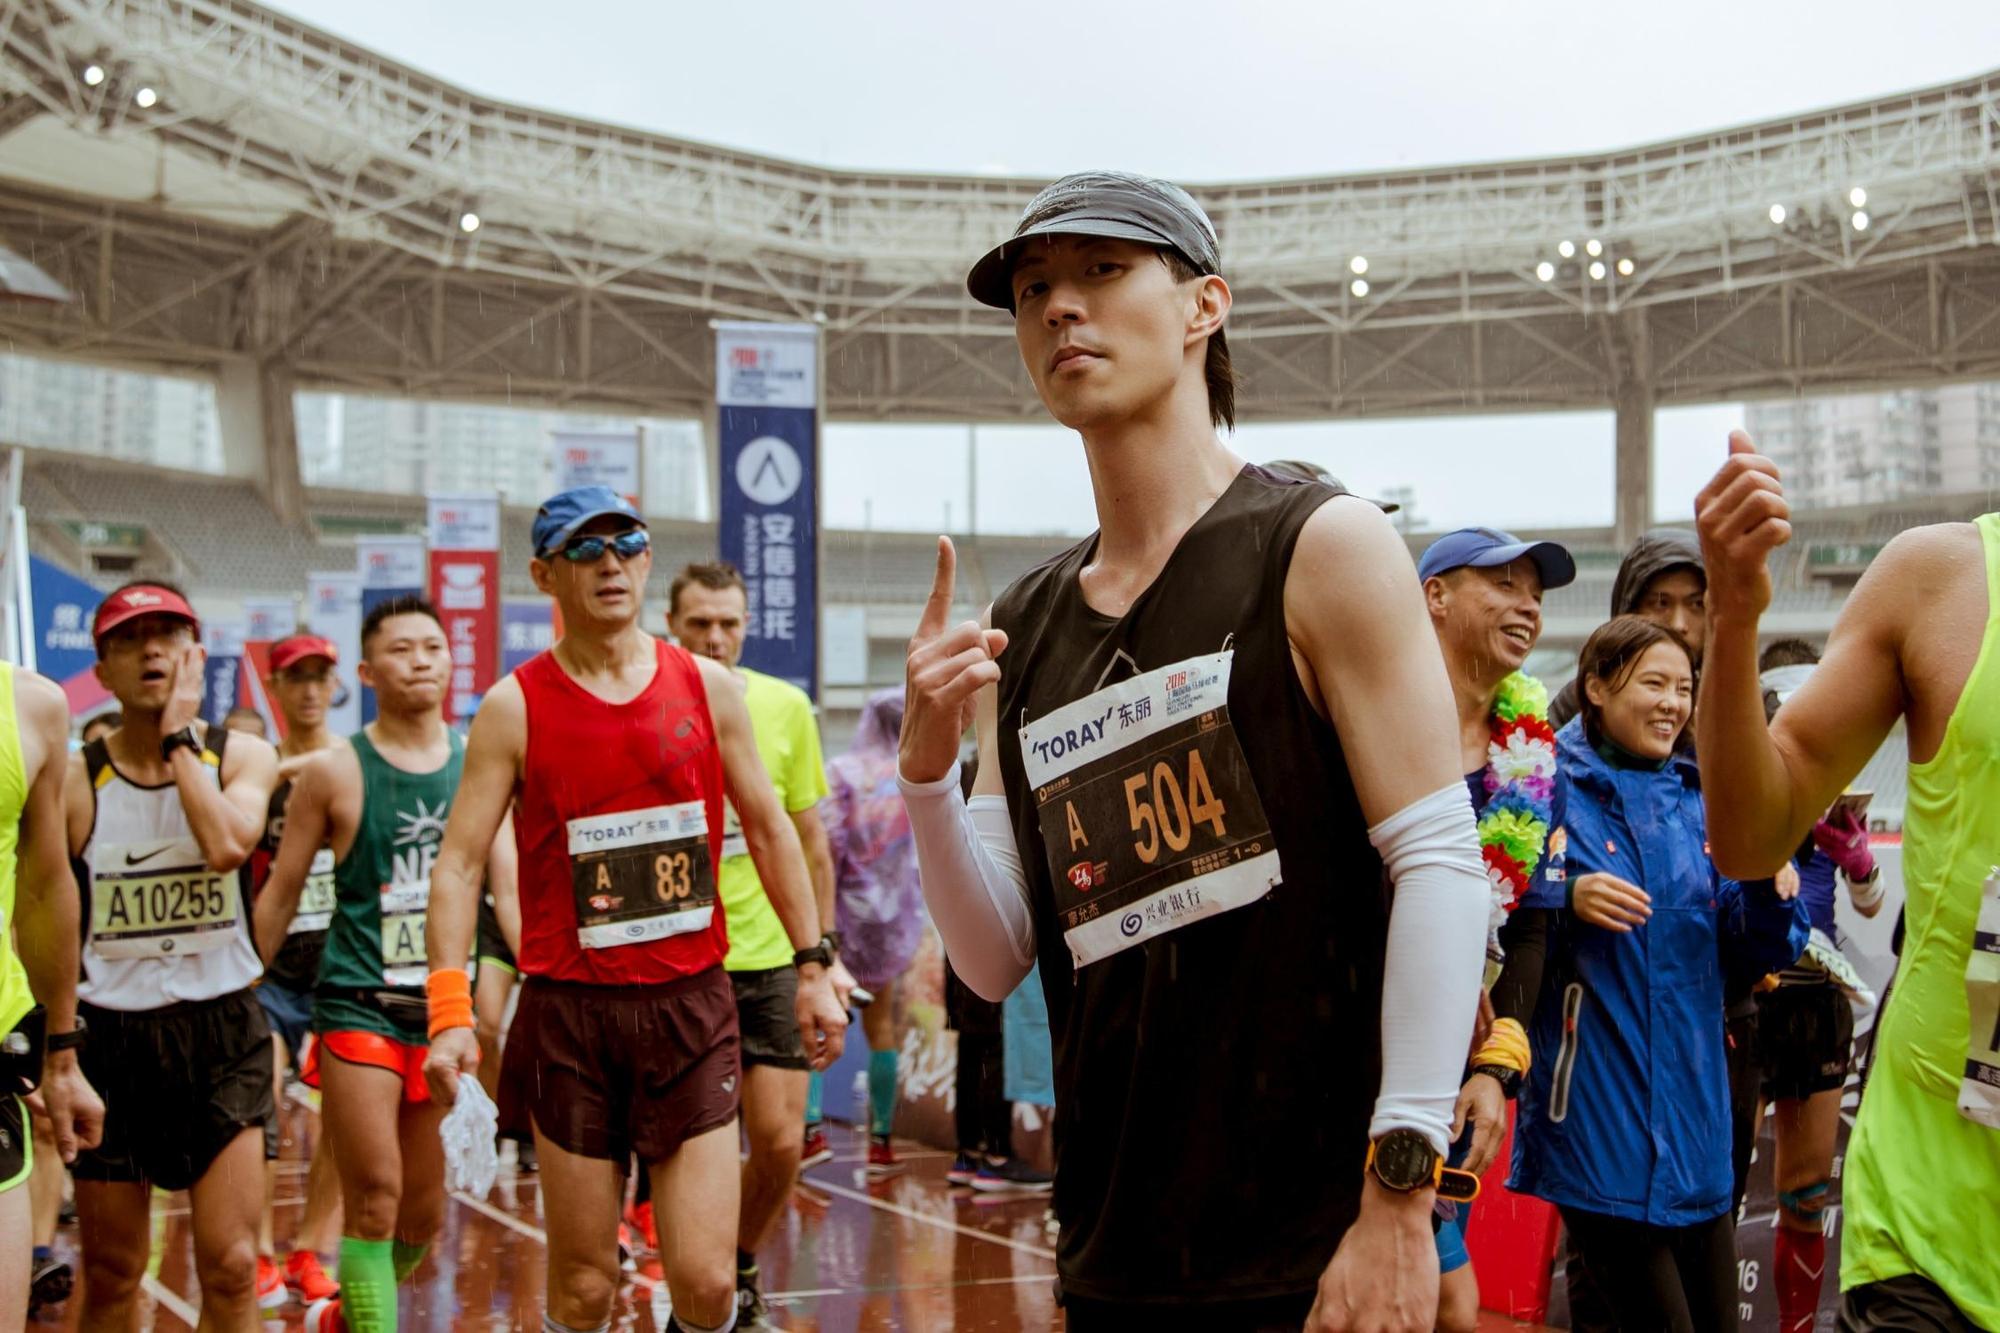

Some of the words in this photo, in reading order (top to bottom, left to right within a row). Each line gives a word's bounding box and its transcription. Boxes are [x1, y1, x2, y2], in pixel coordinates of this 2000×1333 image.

[1117, 696, 1152, 730] 东丽
[1066, 800, 1089, 852] A
[1124, 748, 1227, 864] 504
[596, 863, 612, 890] A
[655, 852, 692, 901] 83
[107, 877, 225, 926] A10255
[1145, 885, 1201, 922] 兴业银行
[1737, 1258, 1760, 1293] 16
